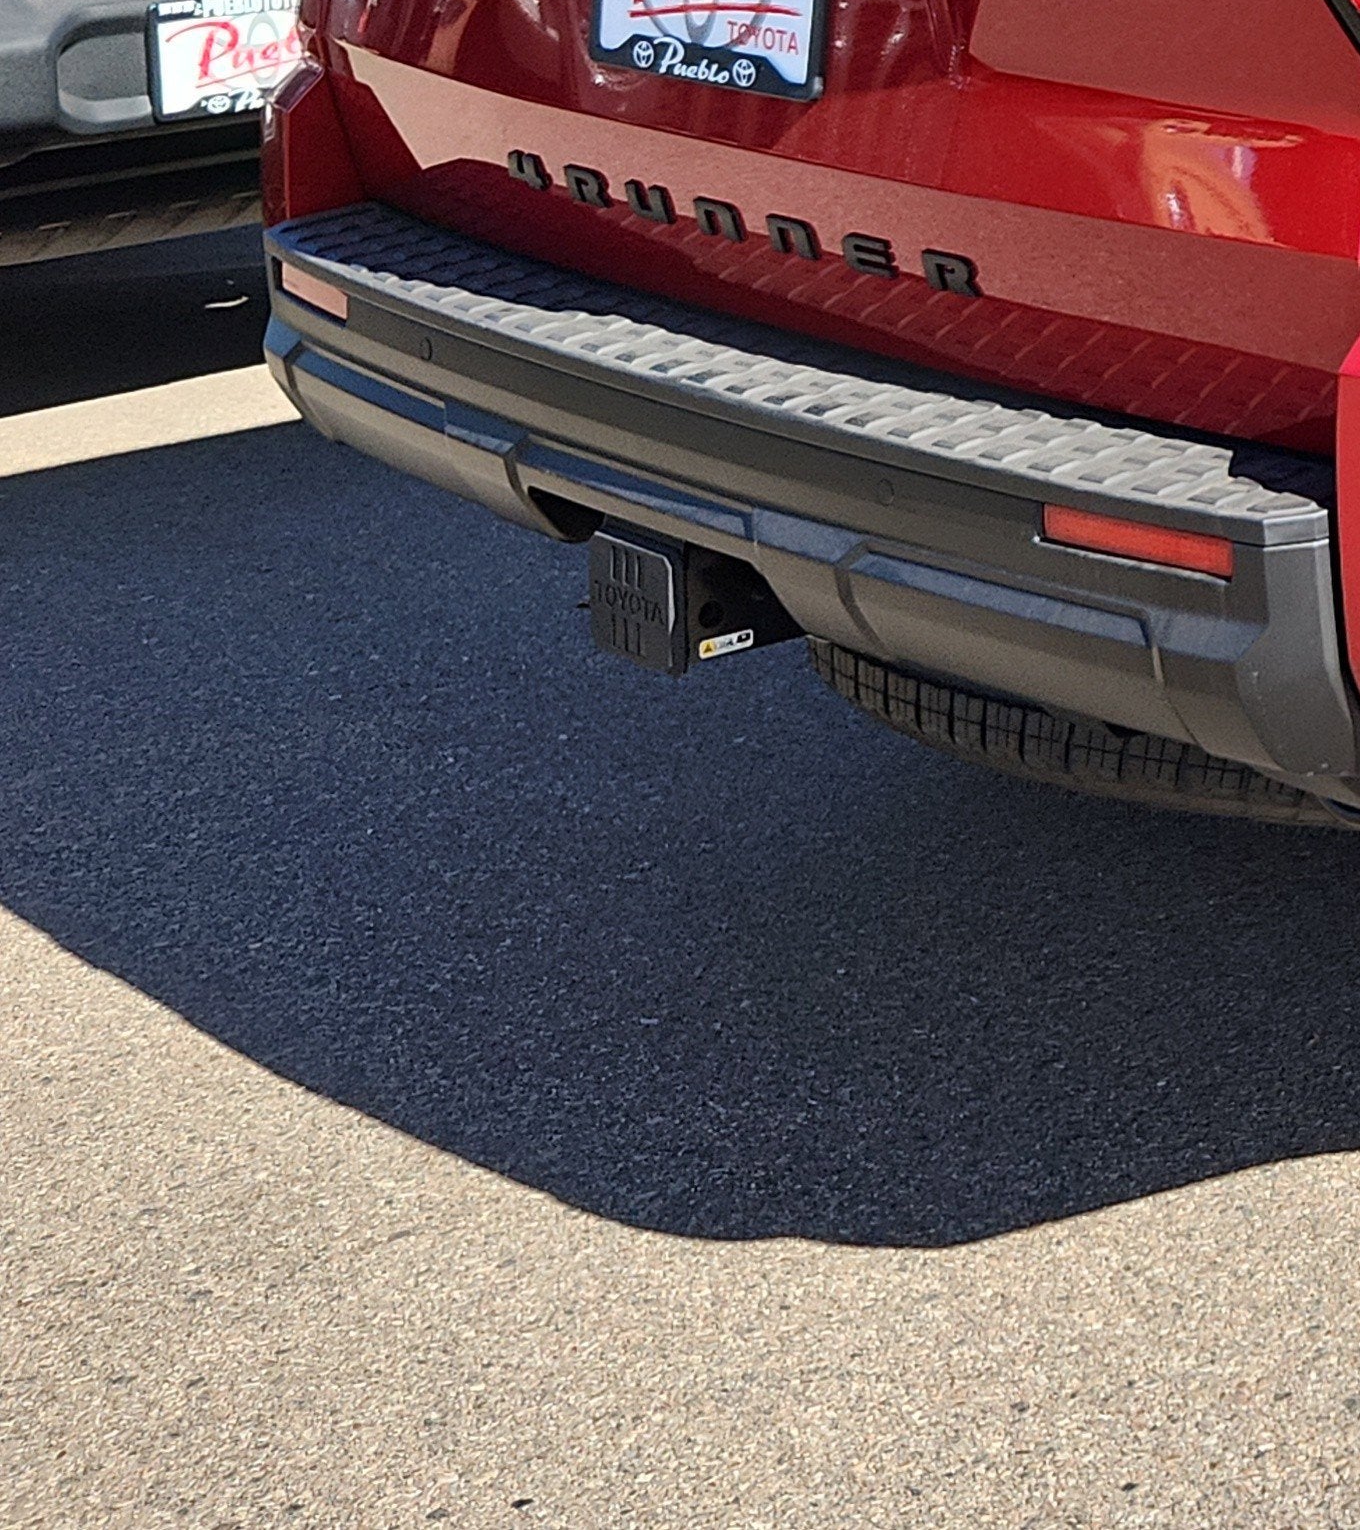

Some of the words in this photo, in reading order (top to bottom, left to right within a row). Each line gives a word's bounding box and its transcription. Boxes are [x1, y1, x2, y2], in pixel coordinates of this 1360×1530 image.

[653, 36, 730, 84] Pueblo
[726, 20, 800, 55] TOYOTA
[507, 149, 984, 298] 4RUNNER
[593, 579, 666, 626] TOYOTA
